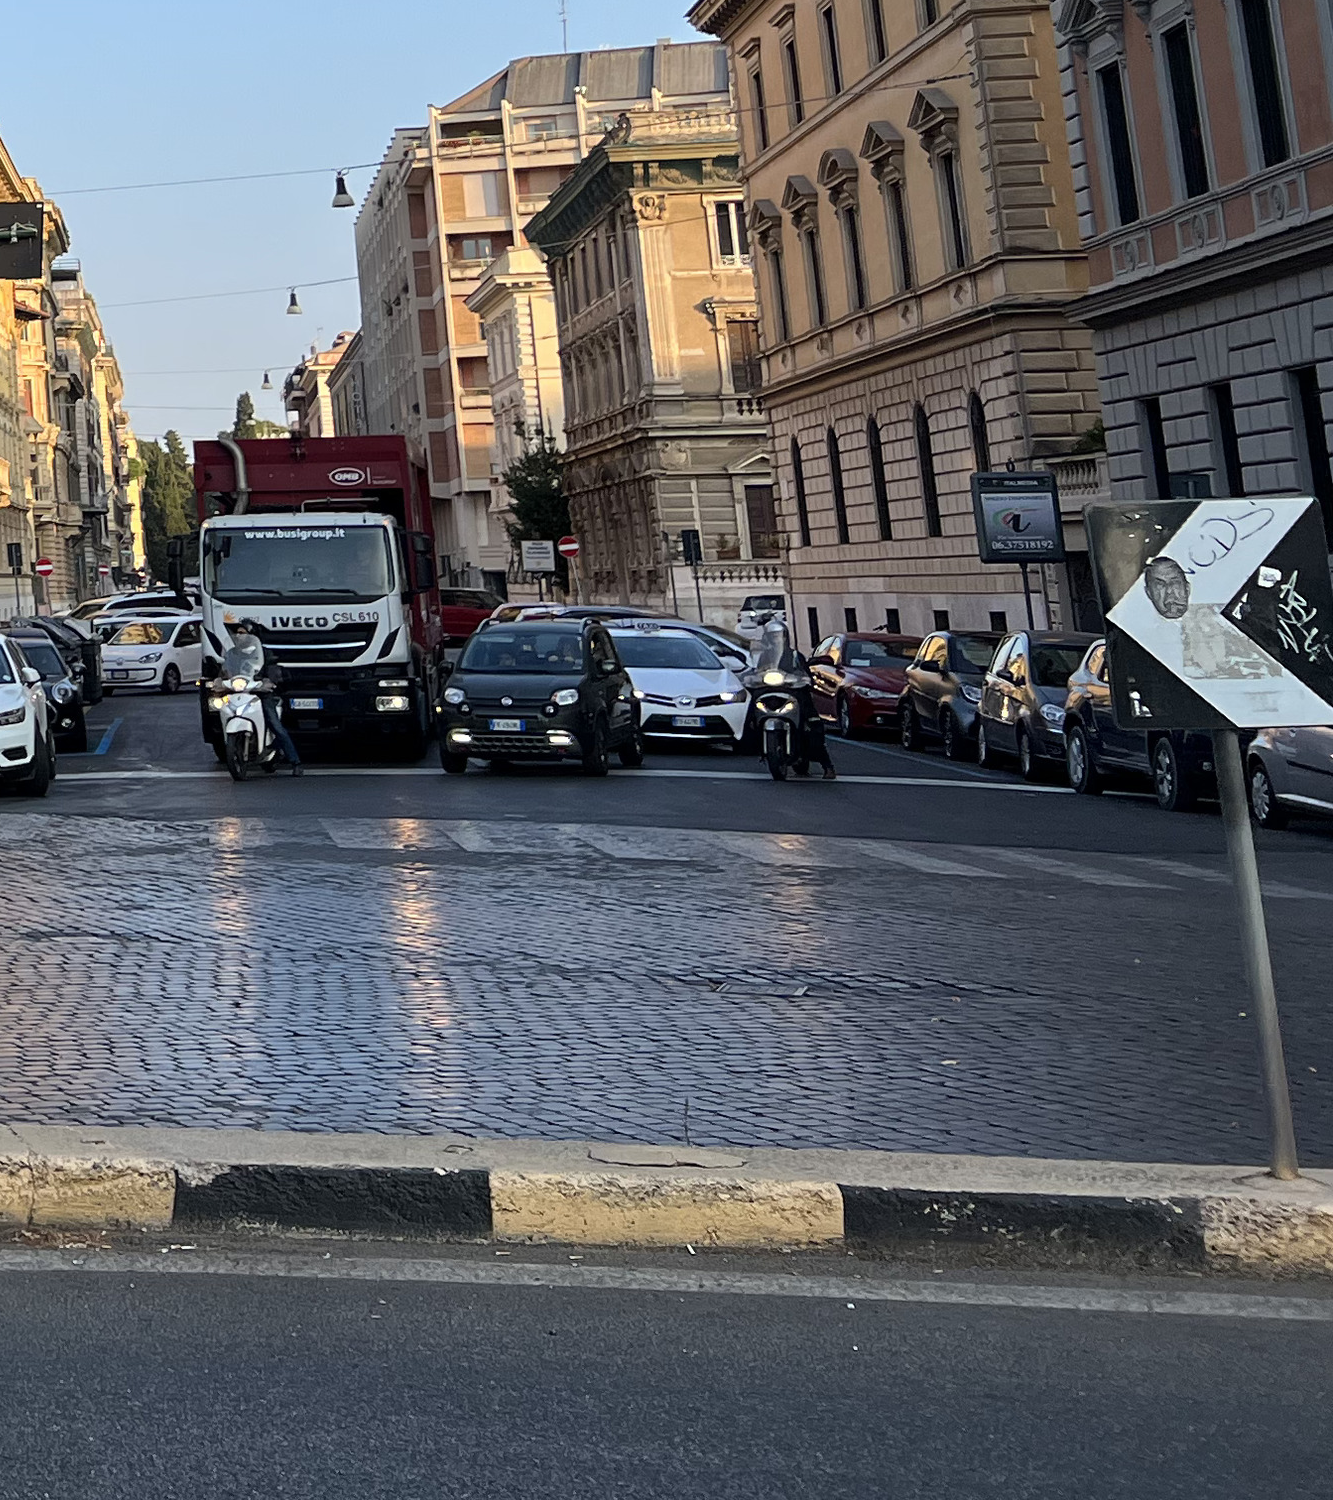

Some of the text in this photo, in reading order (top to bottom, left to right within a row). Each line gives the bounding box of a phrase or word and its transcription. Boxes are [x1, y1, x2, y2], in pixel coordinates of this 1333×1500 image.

[244, 528, 345, 540] www.busigroup.it
[991, 540, 1054, 549] 06.37518192
[271, 616, 329, 628] IVECO
[332, 611, 380, 623] CSL 610
